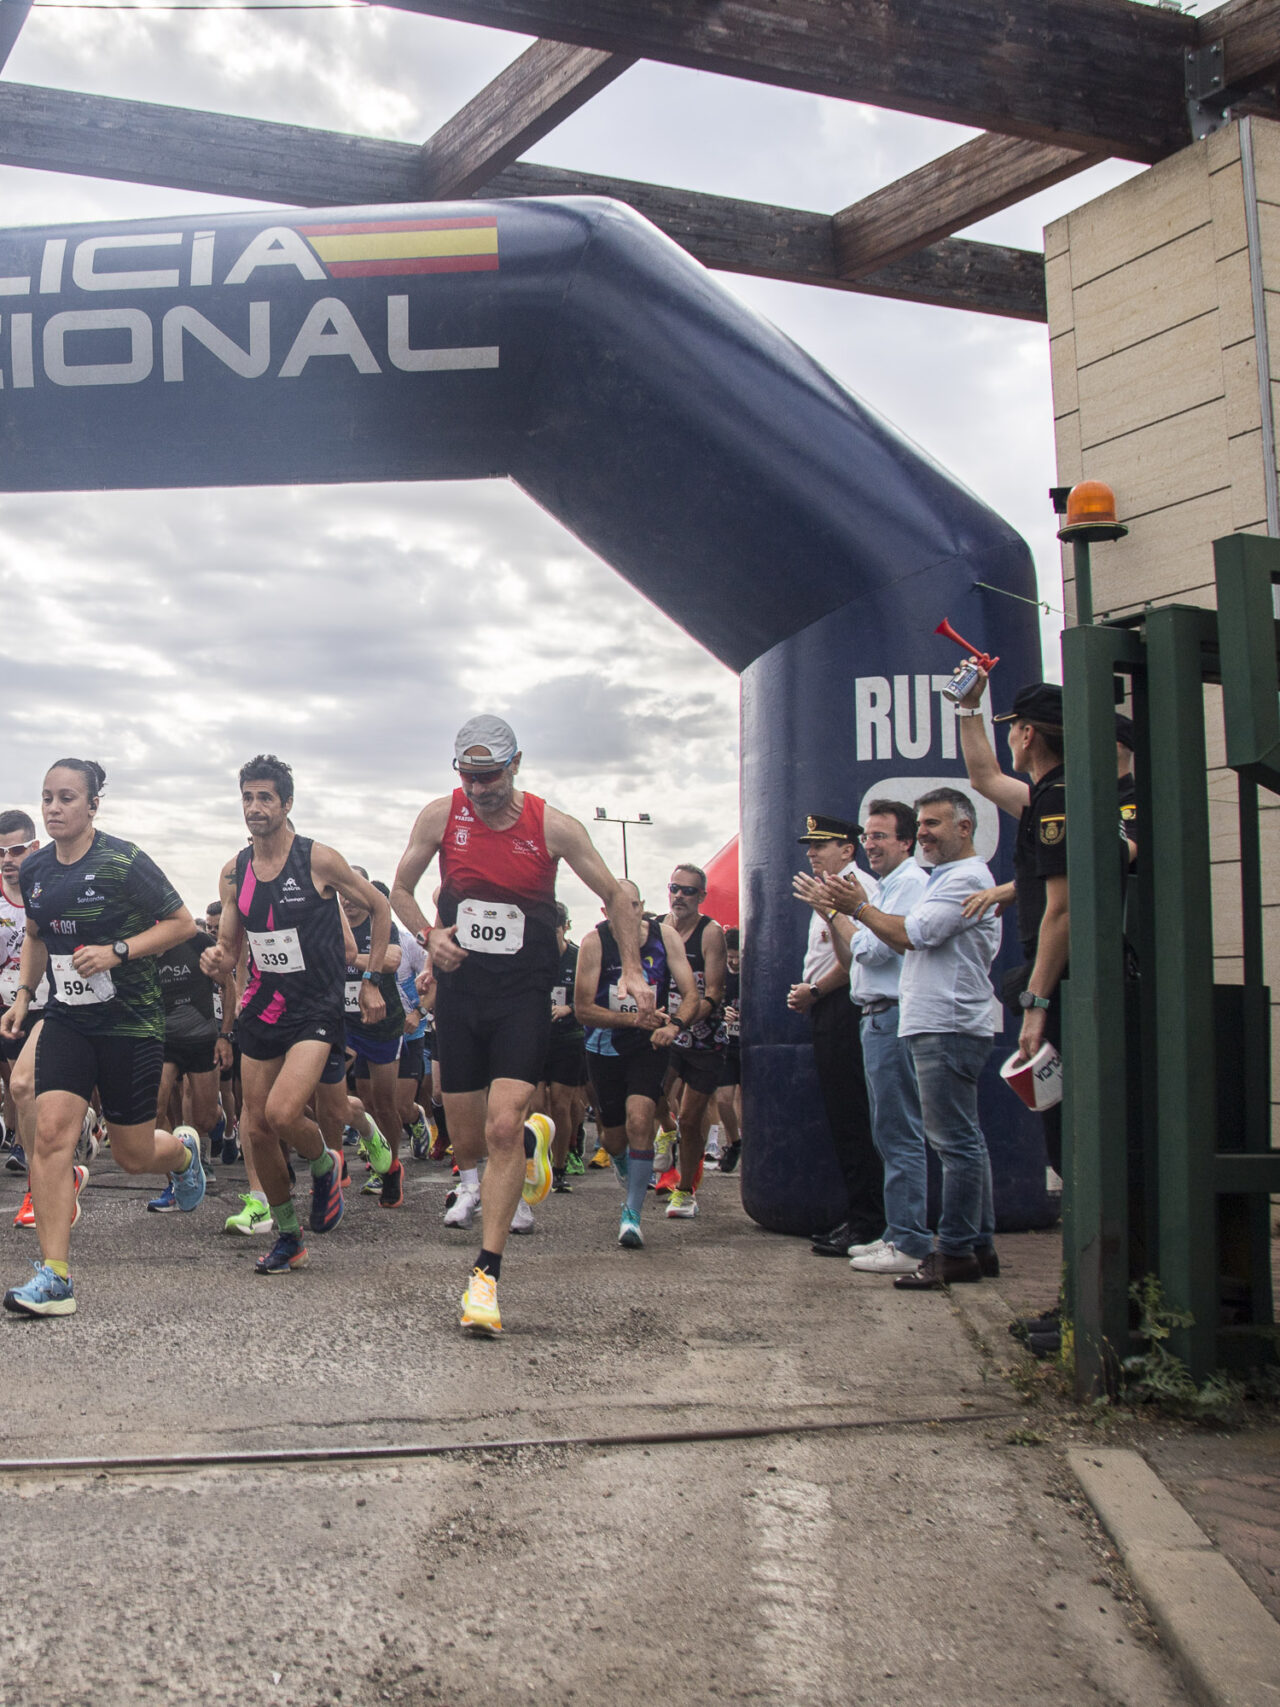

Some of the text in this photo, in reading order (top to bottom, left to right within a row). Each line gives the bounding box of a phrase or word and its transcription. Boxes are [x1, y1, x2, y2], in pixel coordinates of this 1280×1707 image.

[77, 896, 105, 904] Santander
[470, 923, 506, 942] 809
[261, 952, 289, 966] 339
[63, 980, 95, 996] 594
